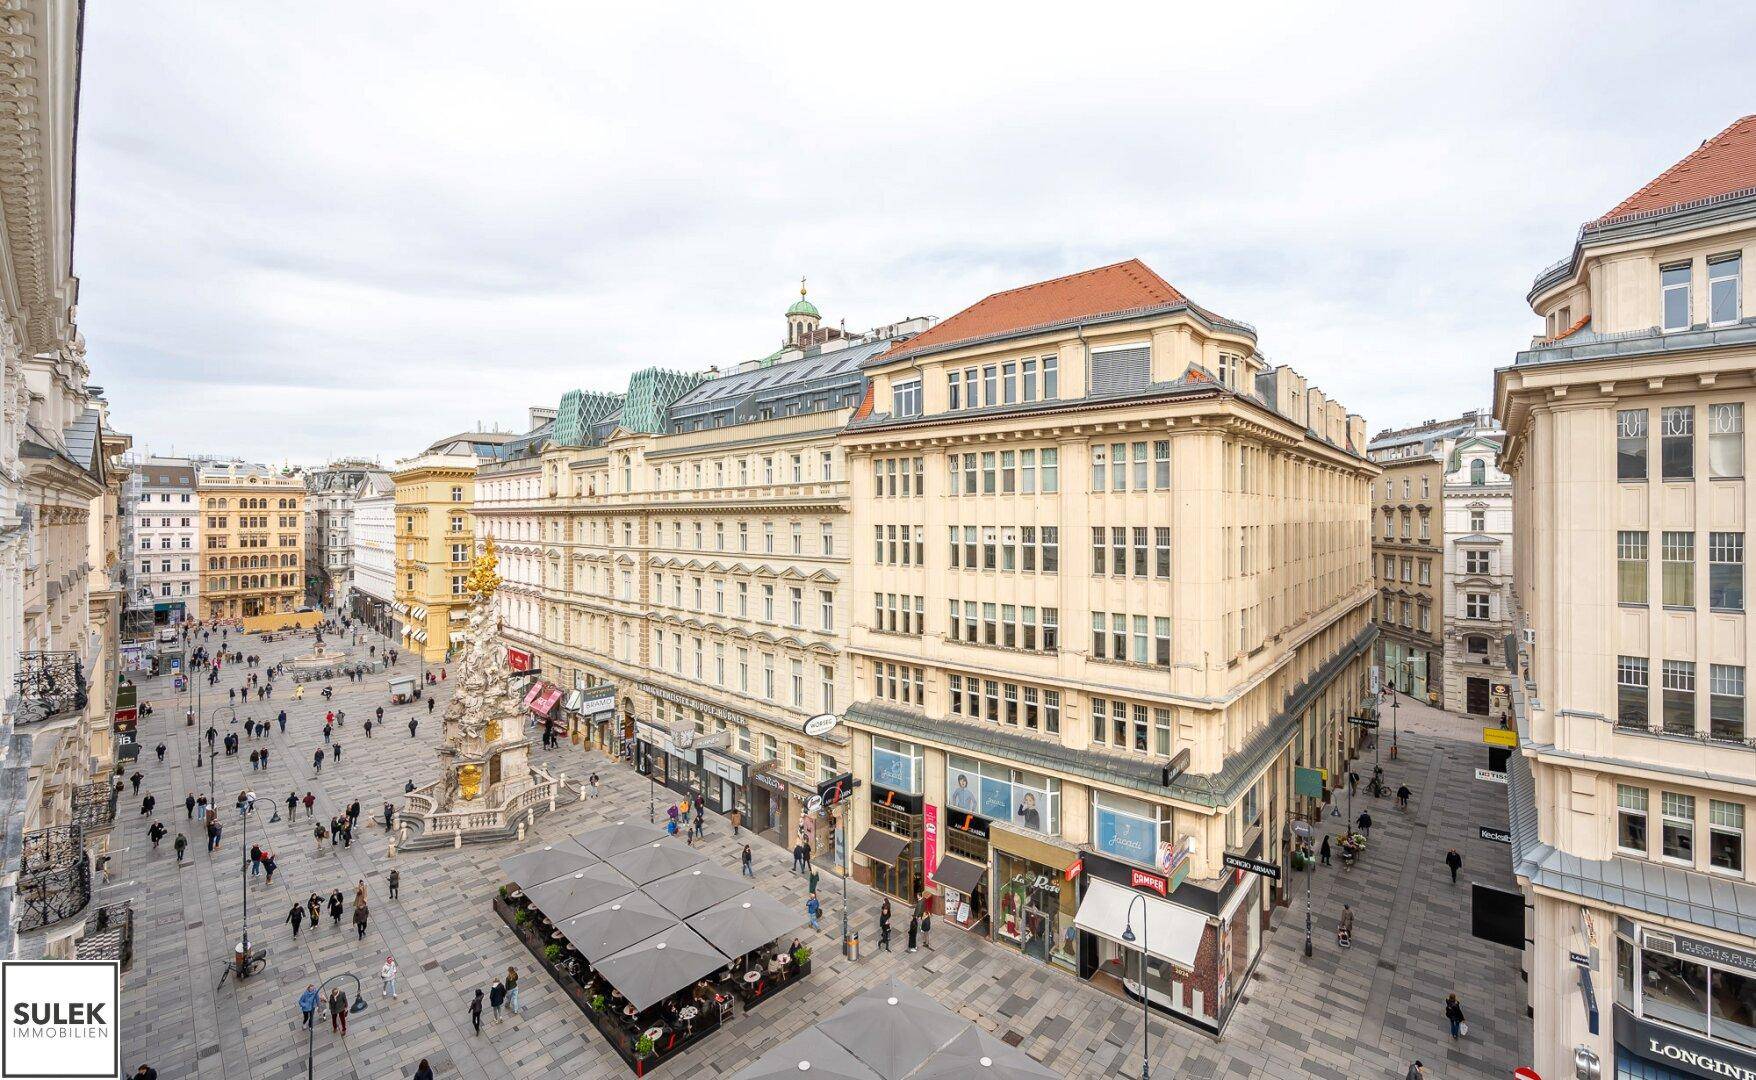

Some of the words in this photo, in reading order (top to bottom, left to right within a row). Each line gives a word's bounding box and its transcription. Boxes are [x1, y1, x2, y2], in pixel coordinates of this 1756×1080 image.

[755, 773, 780, 790] swatch
[1226, 857, 1251, 869] GIORGIO
[1252, 864, 1276, 876] ARMANI
[1133, 872, 1164, 893] CAMPER
[1681, 940, 1720, 956] PLECH
[1721, 951, 1730, 960] &
